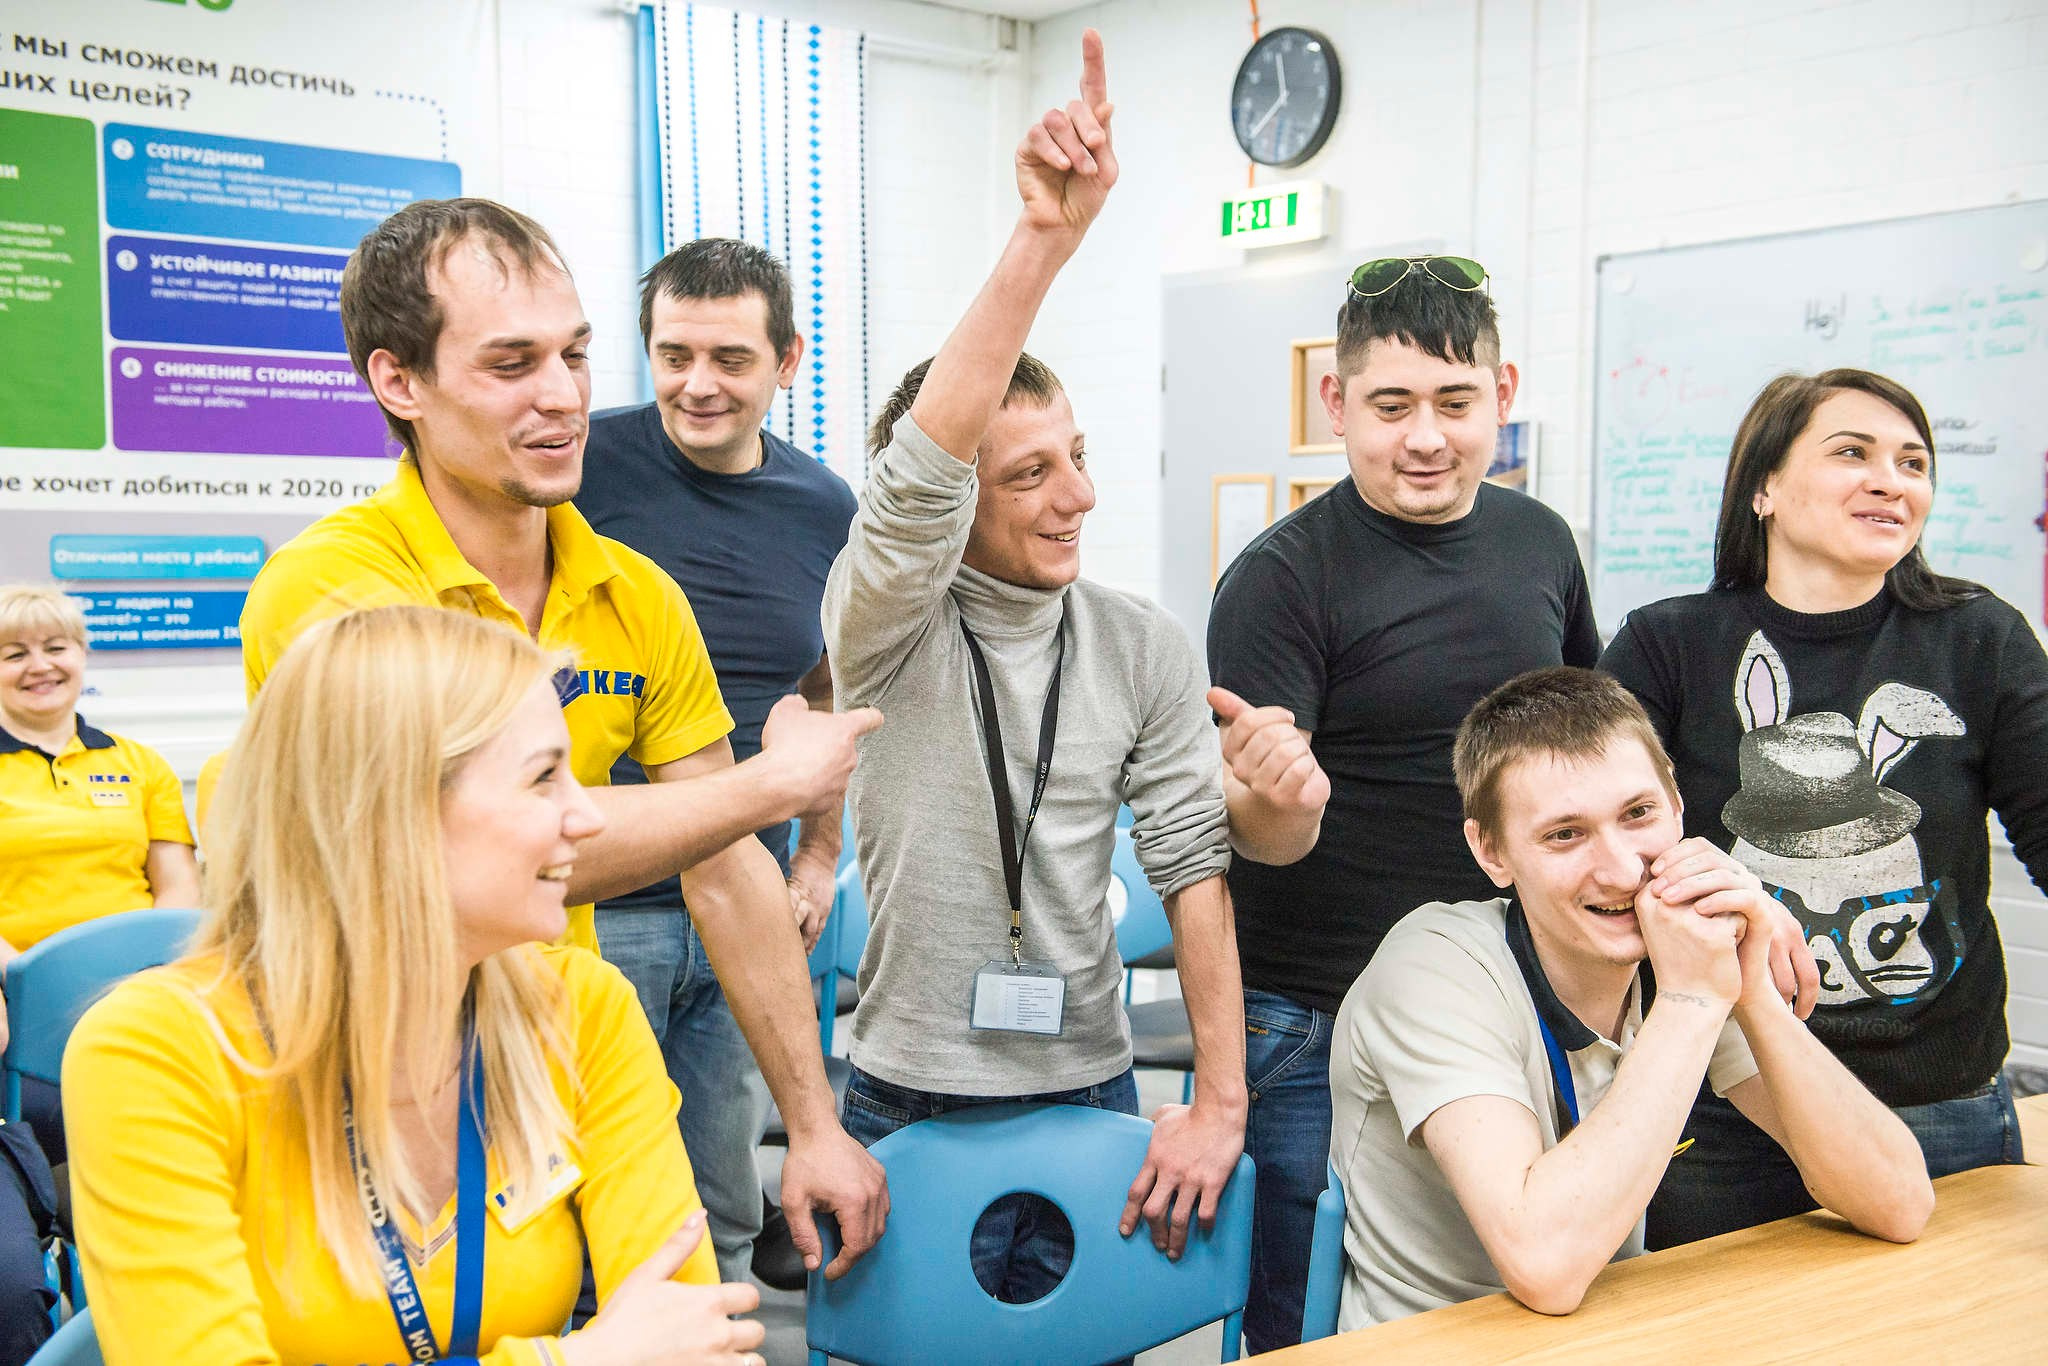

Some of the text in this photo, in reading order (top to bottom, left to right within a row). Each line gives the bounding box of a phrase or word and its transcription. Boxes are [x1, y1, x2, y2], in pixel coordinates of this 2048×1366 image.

[14, 33, 355, 96] мы сможем достичь
[70, 79, 191, 110] целей?
[146, 142, 265, 170] СОТРУДНИКИ
[150, 253, 266, 278] УСТОЙЧИВОЕ
[269, 263, 343, 284] РАЗВИТИ
[1804, 291, 1848, 341] Hej!
[153, 360, 252, 382] СНИЖЕНИЕ
[255, 366, 357, 387] СТОИМОСТИ
[33, 477, 114, 493] хочет
[123, 475, 248, 496] добиться
[258, 481, 272, 496] к
[282, 478, 343, 498] 2020
[89, 775, 131, 783] IKEA
[383, 1257, 421, 1327] TEAM
